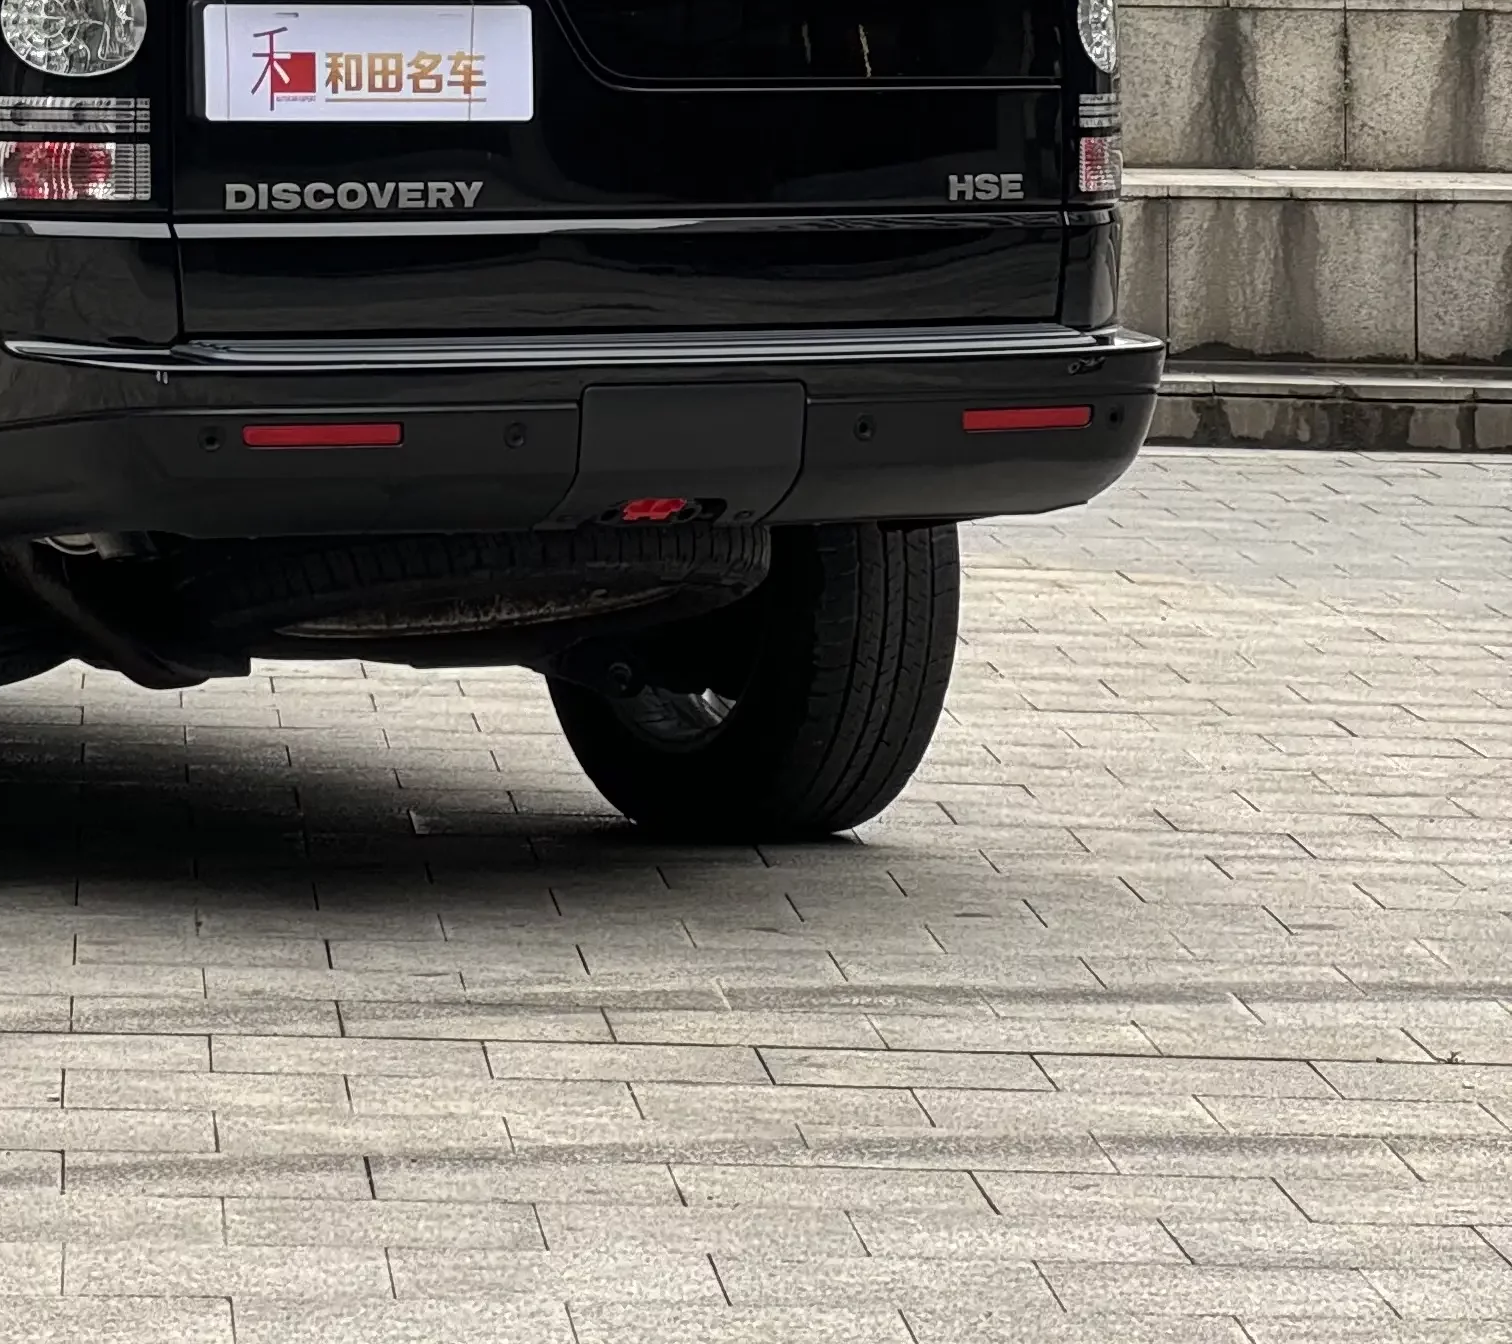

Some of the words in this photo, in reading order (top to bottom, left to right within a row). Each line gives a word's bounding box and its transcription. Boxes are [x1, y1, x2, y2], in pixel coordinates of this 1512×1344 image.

[325, 50, 487, 95] 和田名车
[225, 181, 484, 211] DISCOVERY
[948, 173, 1024, 201] HSE
